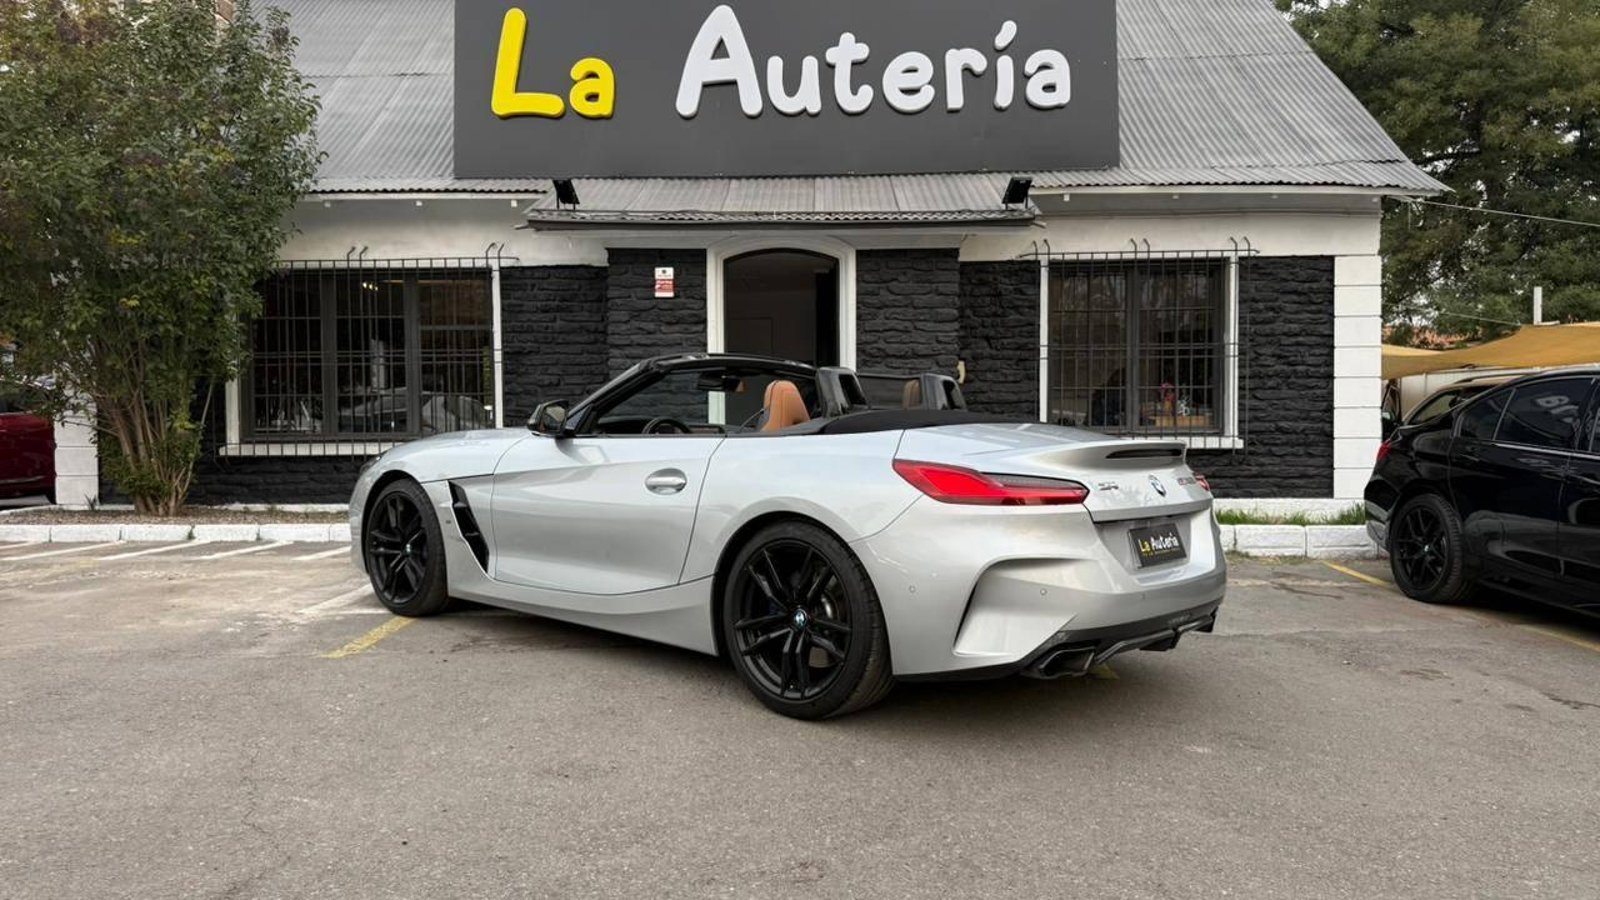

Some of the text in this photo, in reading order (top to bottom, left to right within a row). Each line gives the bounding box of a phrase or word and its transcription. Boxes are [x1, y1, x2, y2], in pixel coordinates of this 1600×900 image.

[491, 4, 1072, 119] La Autería
[1138, 538, 1152, 552] La
